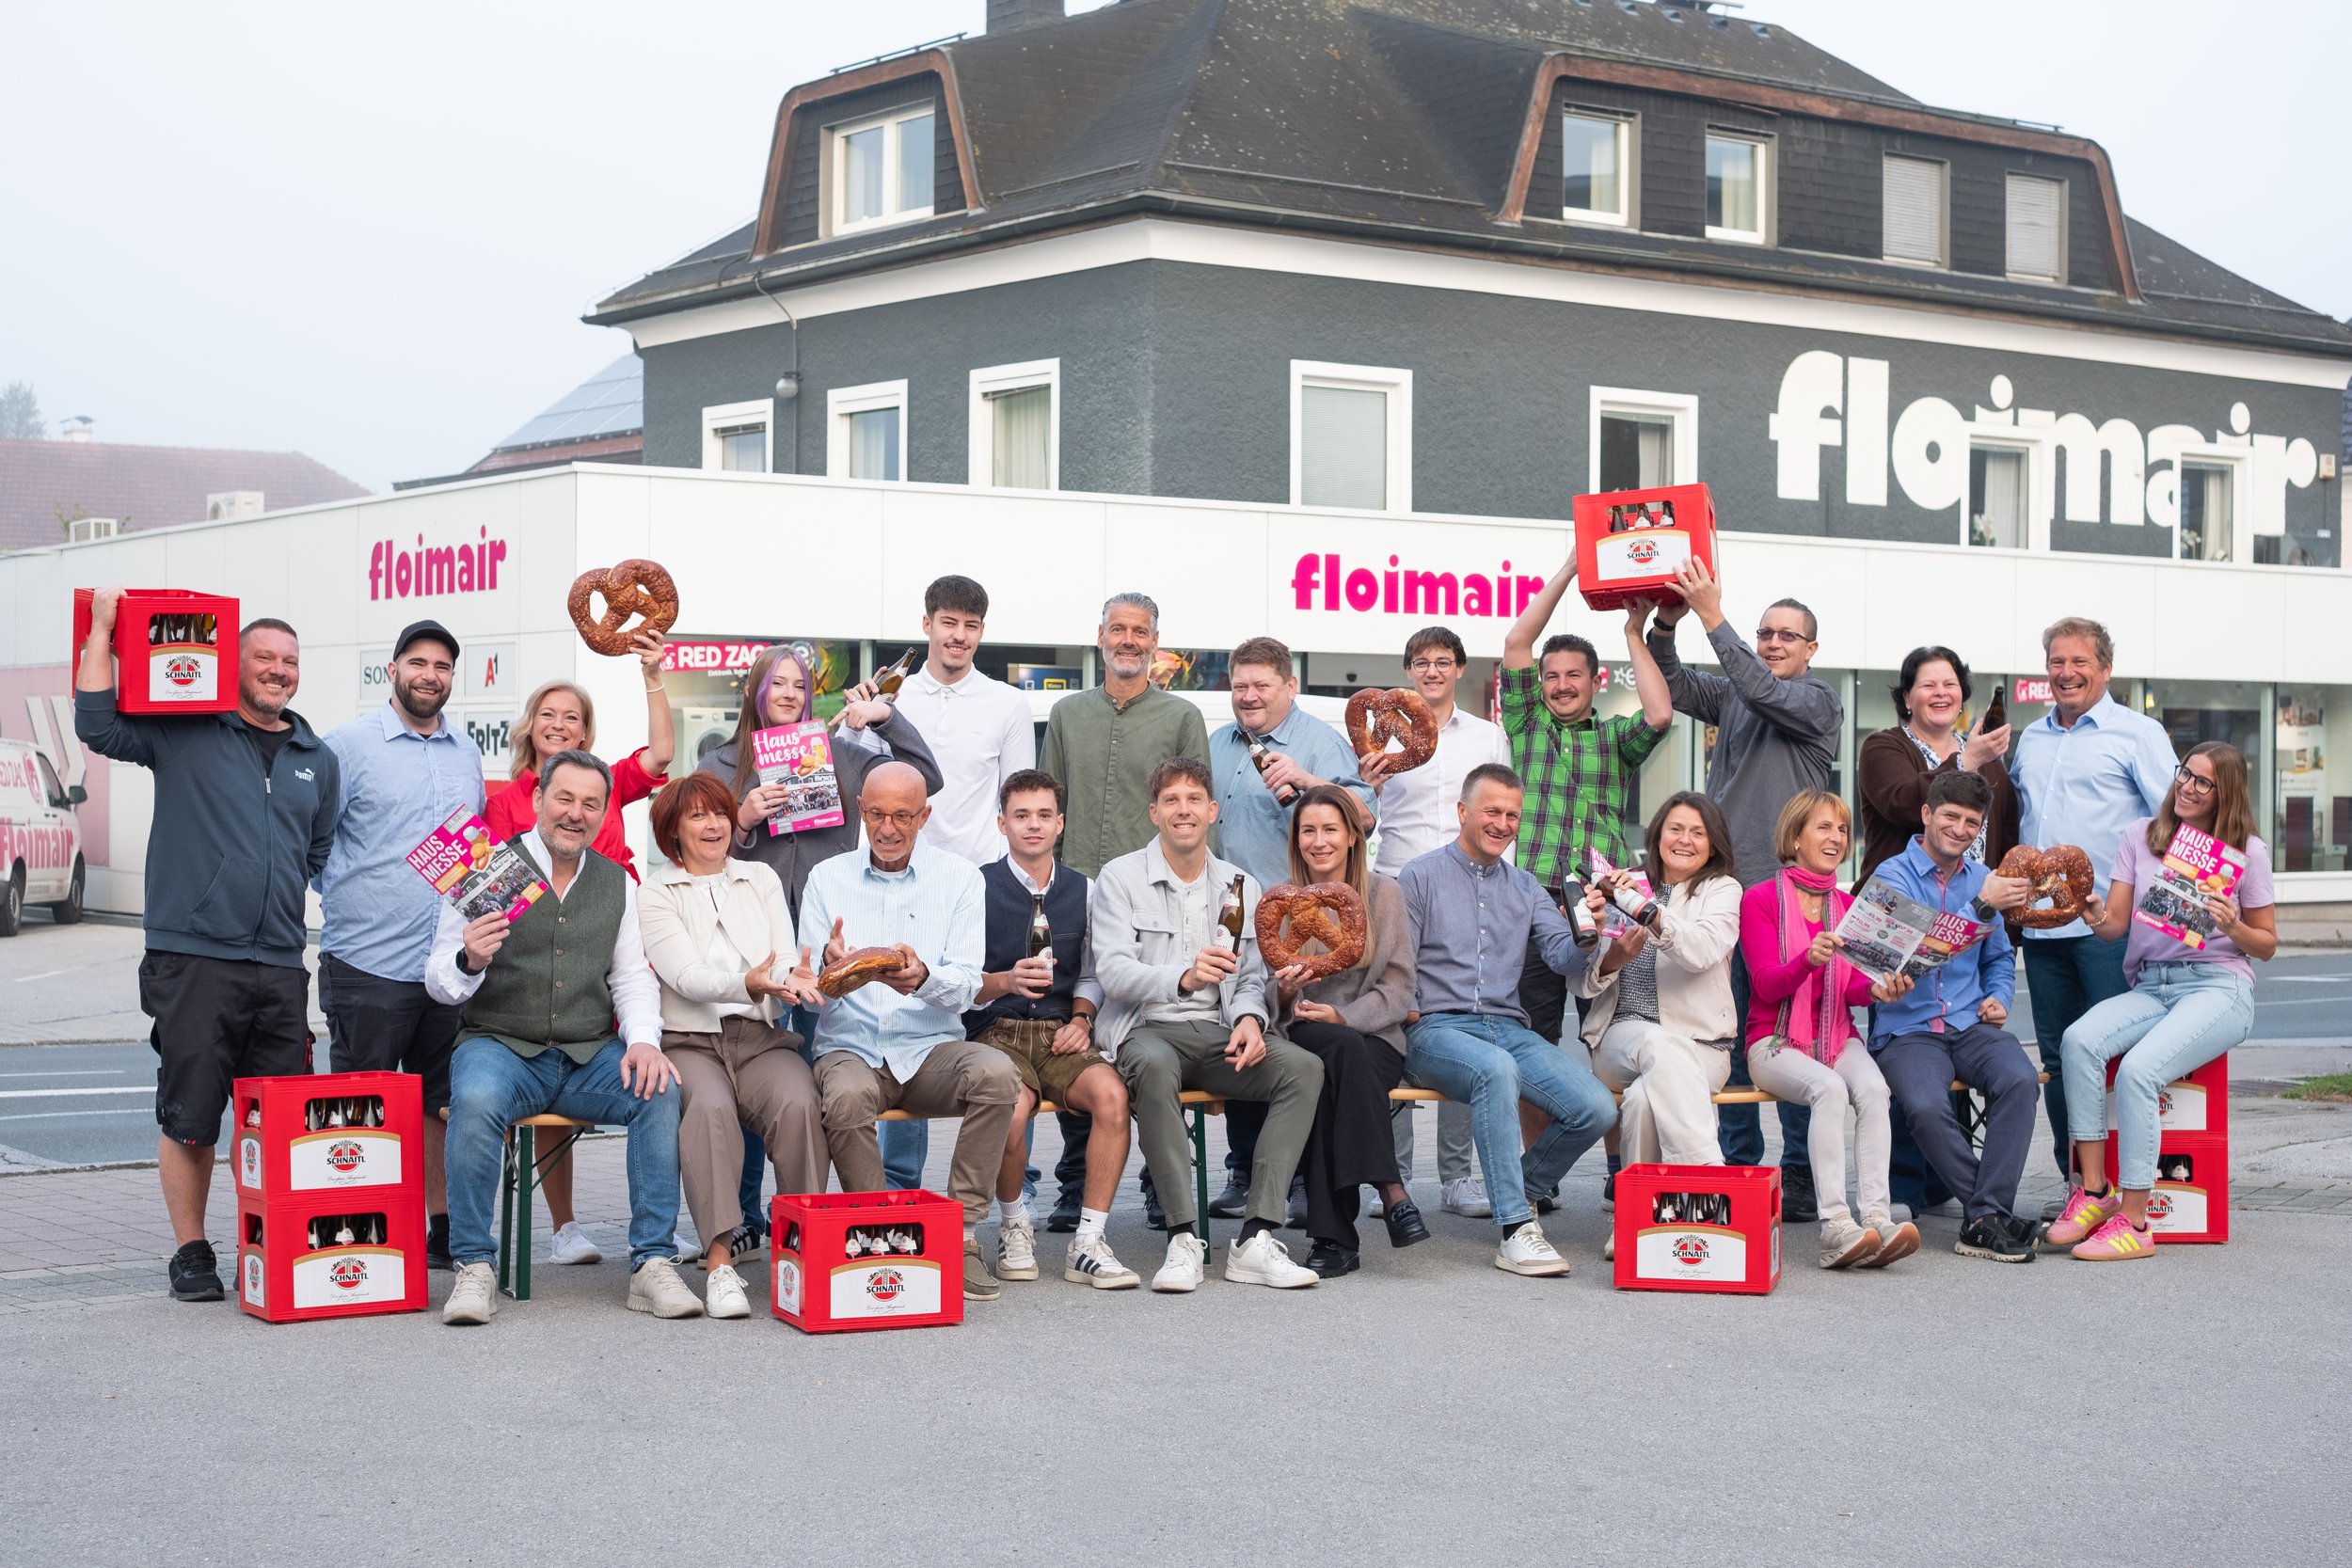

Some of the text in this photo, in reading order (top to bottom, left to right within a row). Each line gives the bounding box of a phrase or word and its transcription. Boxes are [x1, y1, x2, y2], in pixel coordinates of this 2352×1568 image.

[369, 524, 507, 601] floimair
[1627, 550, 1661, 559] SCHNAITL
[1291, 552, 1545, 618] floimair
[677, 645, 723, 669] RED
[165, 671, 202, 679] SCHNAITL
[363, 666, 391, 685] SON
[754, 731, 801, 753] Haus
[758, 744, 810, 766] messe
[2176, 825, 2215, 853] HAUS
[407, 834, 445, 870] HAUS
[421, 838, 469, 883] MESSE
[2169, 839, 2218, 874] MESSE
[1934, 911, 1969, 933] HAUS
[326, 1155, 366, 1165] SCHNAITL
[1672, 1250, 1711, 1259] SCHNAITL
[329, 1273, 369, 1283] SCHNAITL
[866, 1284, 905, 1294] SCHNAITL
